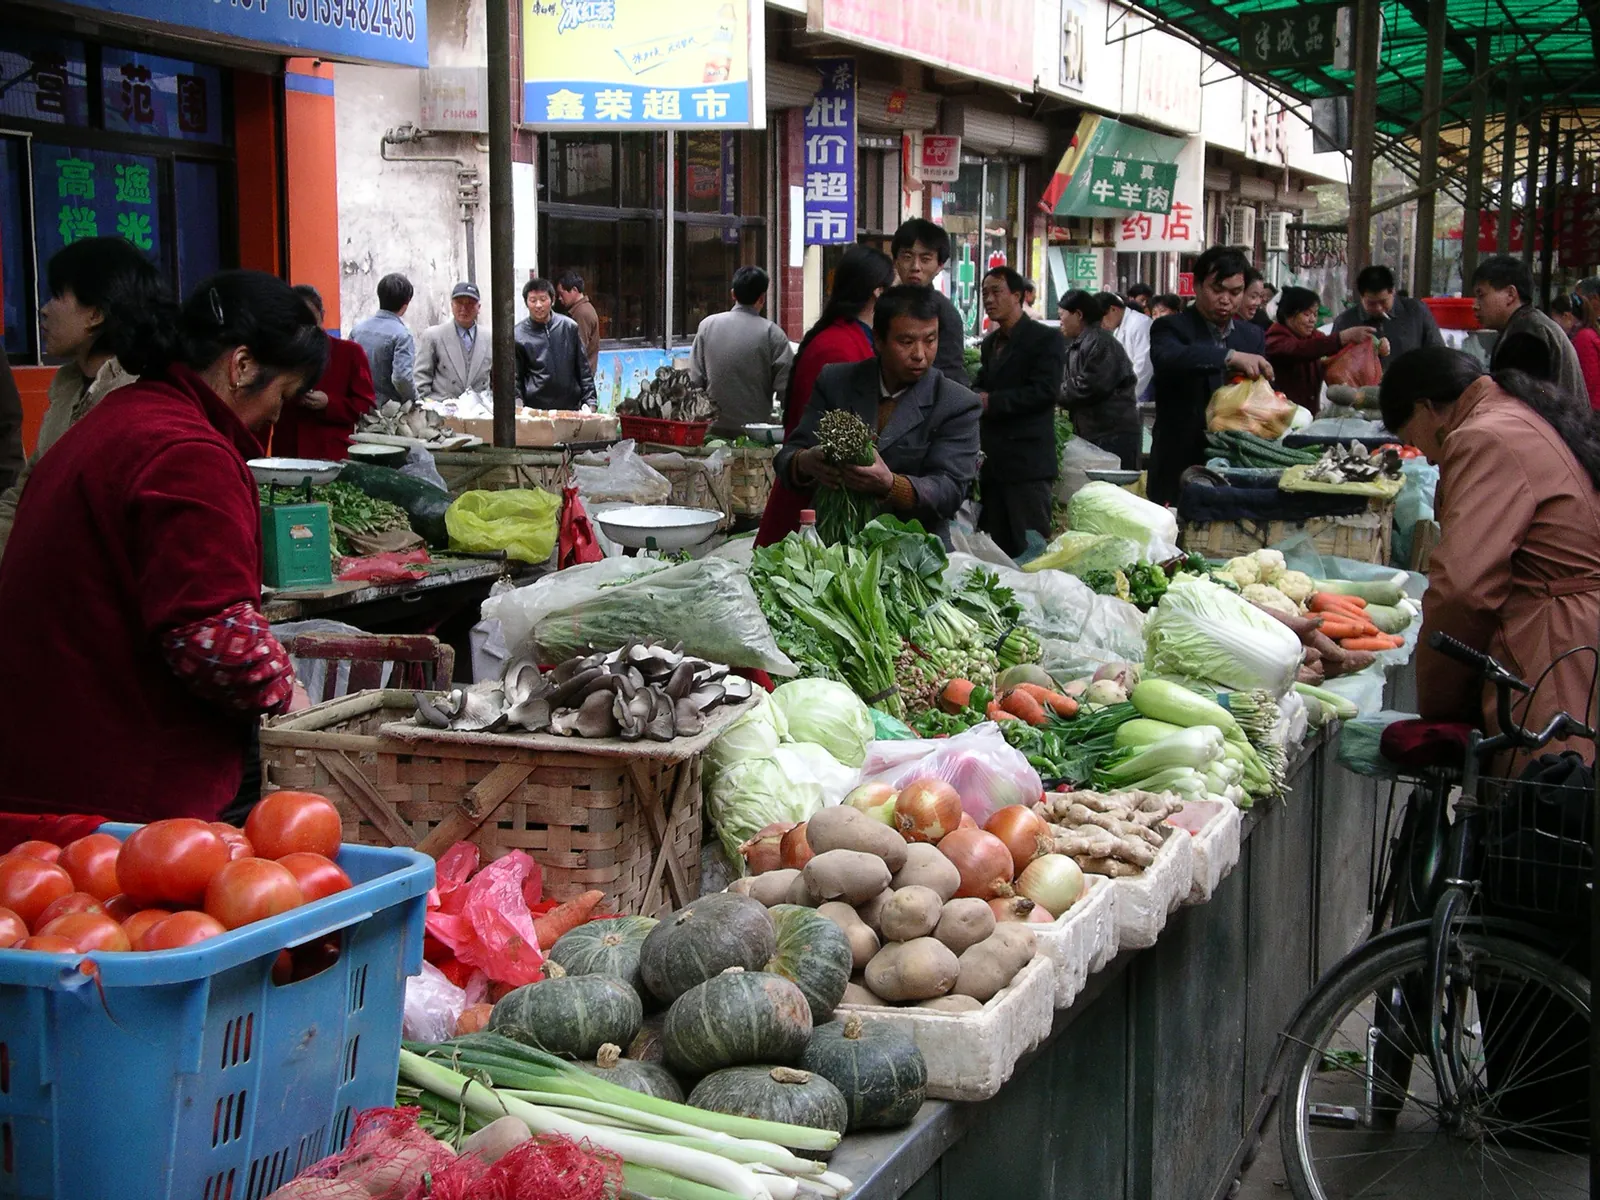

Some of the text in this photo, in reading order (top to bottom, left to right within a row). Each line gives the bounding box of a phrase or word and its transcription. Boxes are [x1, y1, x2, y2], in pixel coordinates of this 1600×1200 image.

[546, 88, 731, 121] 鑫荣超市
[805, 97, 848, 240] 批价超市
[1111, 160, 1156, 181] 清真
[1091, 179, 1171, 212] 牛羊肉
[1074, 253, 1098, 293] 医
